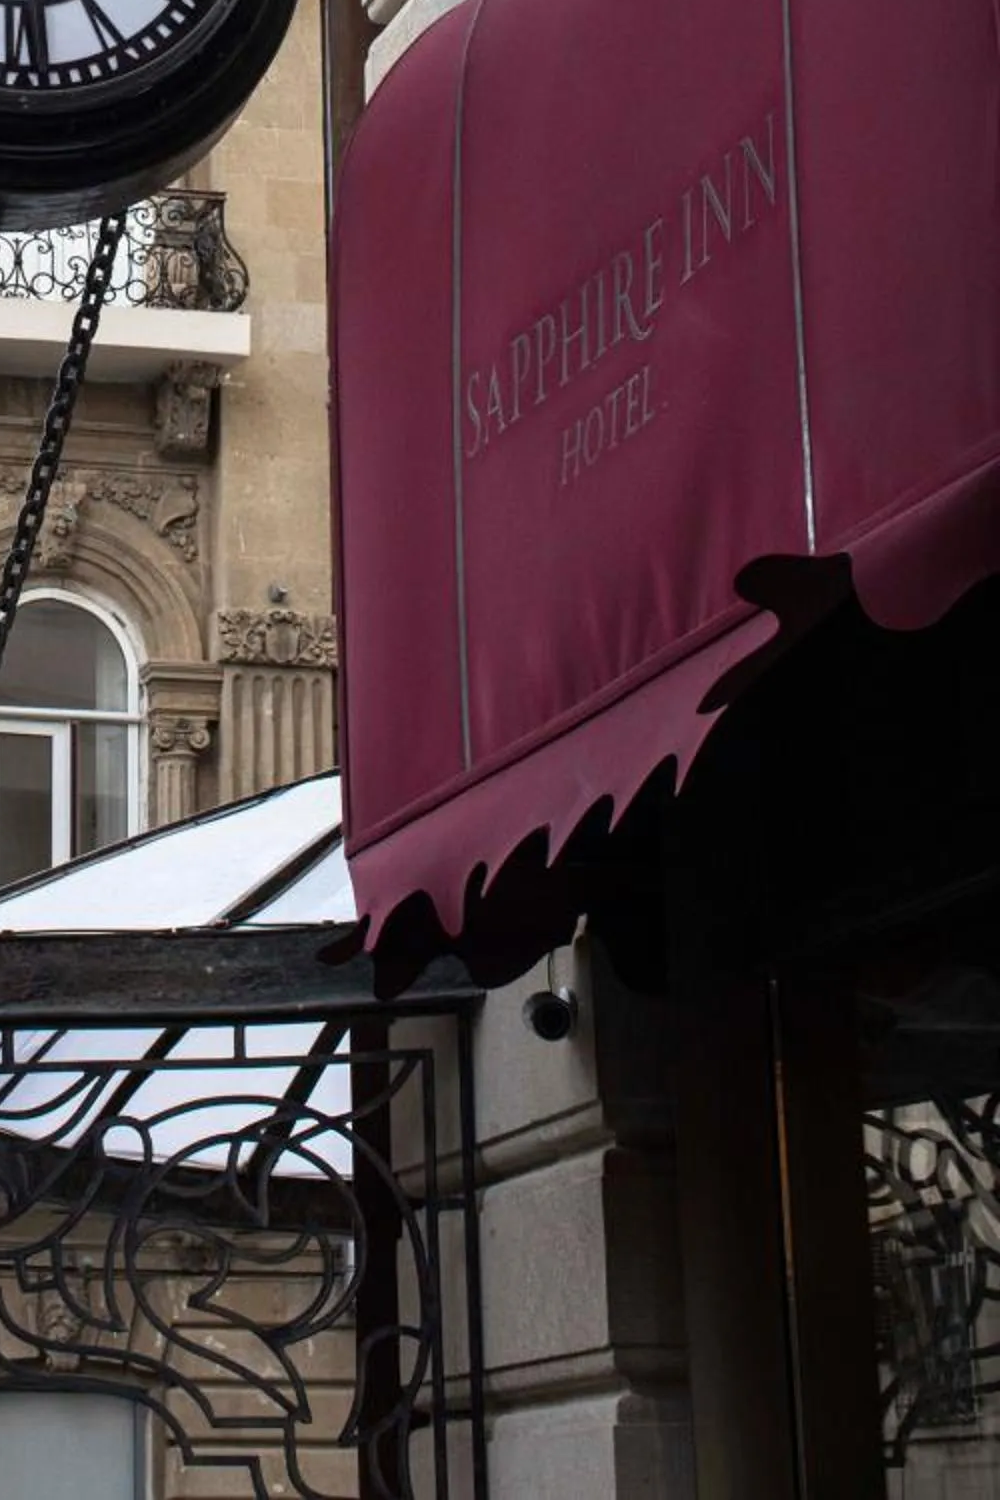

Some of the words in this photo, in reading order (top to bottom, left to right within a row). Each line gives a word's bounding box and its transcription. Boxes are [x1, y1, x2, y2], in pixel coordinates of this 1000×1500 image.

[466, 219, 664, 457] SAPPHIRE
[680, 113, 776, 286] INN
[560, 365, 655, 486] HOTEL
